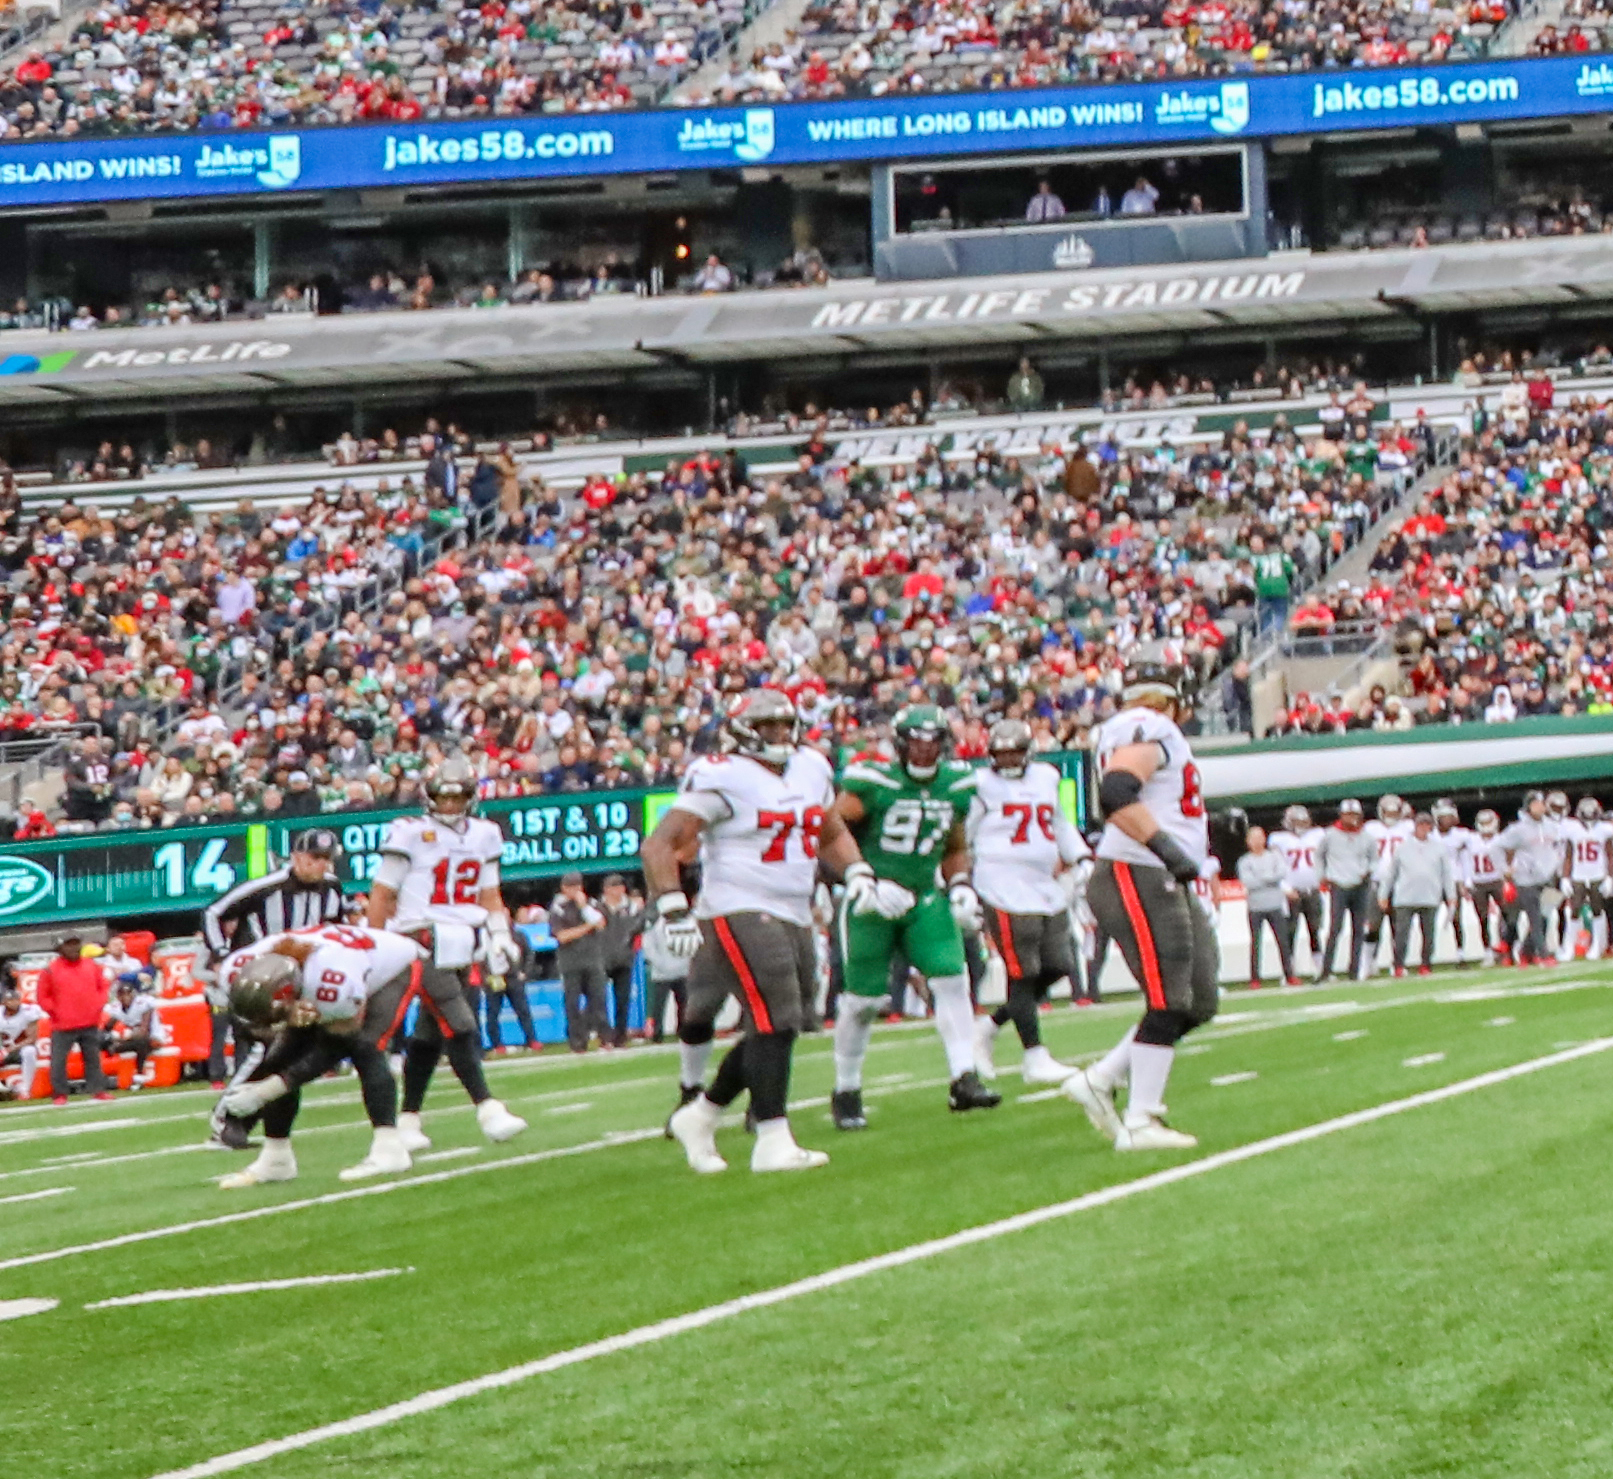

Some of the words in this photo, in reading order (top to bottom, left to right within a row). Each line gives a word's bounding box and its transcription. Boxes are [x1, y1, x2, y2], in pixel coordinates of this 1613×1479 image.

[1312, 77, 1519, 118] jakes58.com
[807, 116, 898, 141] WHERE
[903, 111, 972, 136] LONG
[977, 107, 1068, 131] ISLAND
[1072, 103, 1144, 125] WINS!
[0, 159, 95, 184] SLAND
[100, 154, 182, 179] WINS!
[383, 128, 614, 171] jakes58.com
[811, 286, 1050, 328] METLIFE
[1062, 272, 1305, 311] STADIUM
[83, 341, 291, 370] MetLife
[509, 805, 562, 837] 1ST
[564, 805, 588, 834] &
[594, 801, 629, 829] 10
[880, 799, 953, 855] 97
[501, 839, 562, 865] BALL
[561, 834, 598, 860] ON
[604, 828, 640, 857] 23
[154, 838, 235, 898] 14
[431, 858, 481, 905] 12
